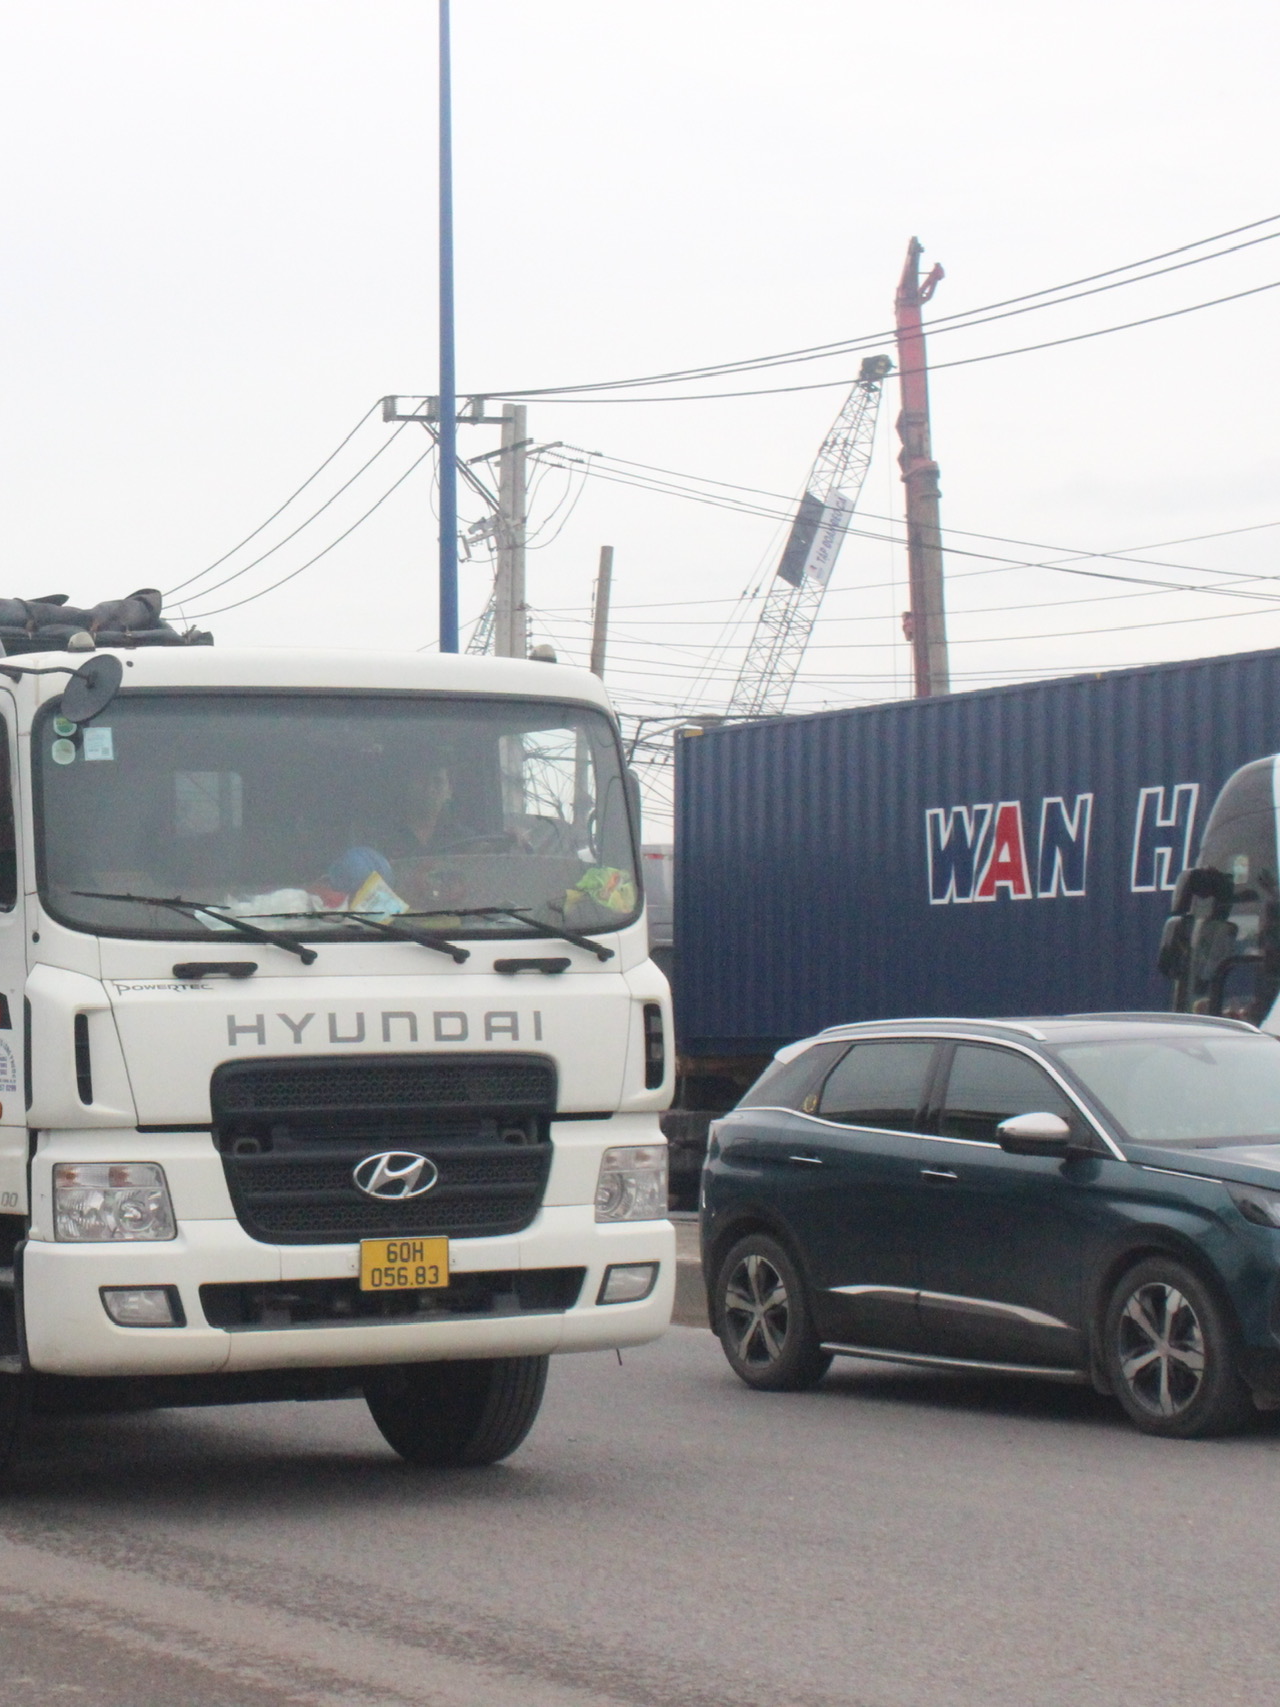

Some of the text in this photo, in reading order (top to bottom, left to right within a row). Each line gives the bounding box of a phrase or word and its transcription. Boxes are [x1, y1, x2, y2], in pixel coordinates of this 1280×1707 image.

[926, 793, 1094, 904] WAN
[227, 1010, 543, 1047] HYUNDAI
[387, 1241, 424, 1263] 60H
[371, 1265, 439, 1287] 056.83
